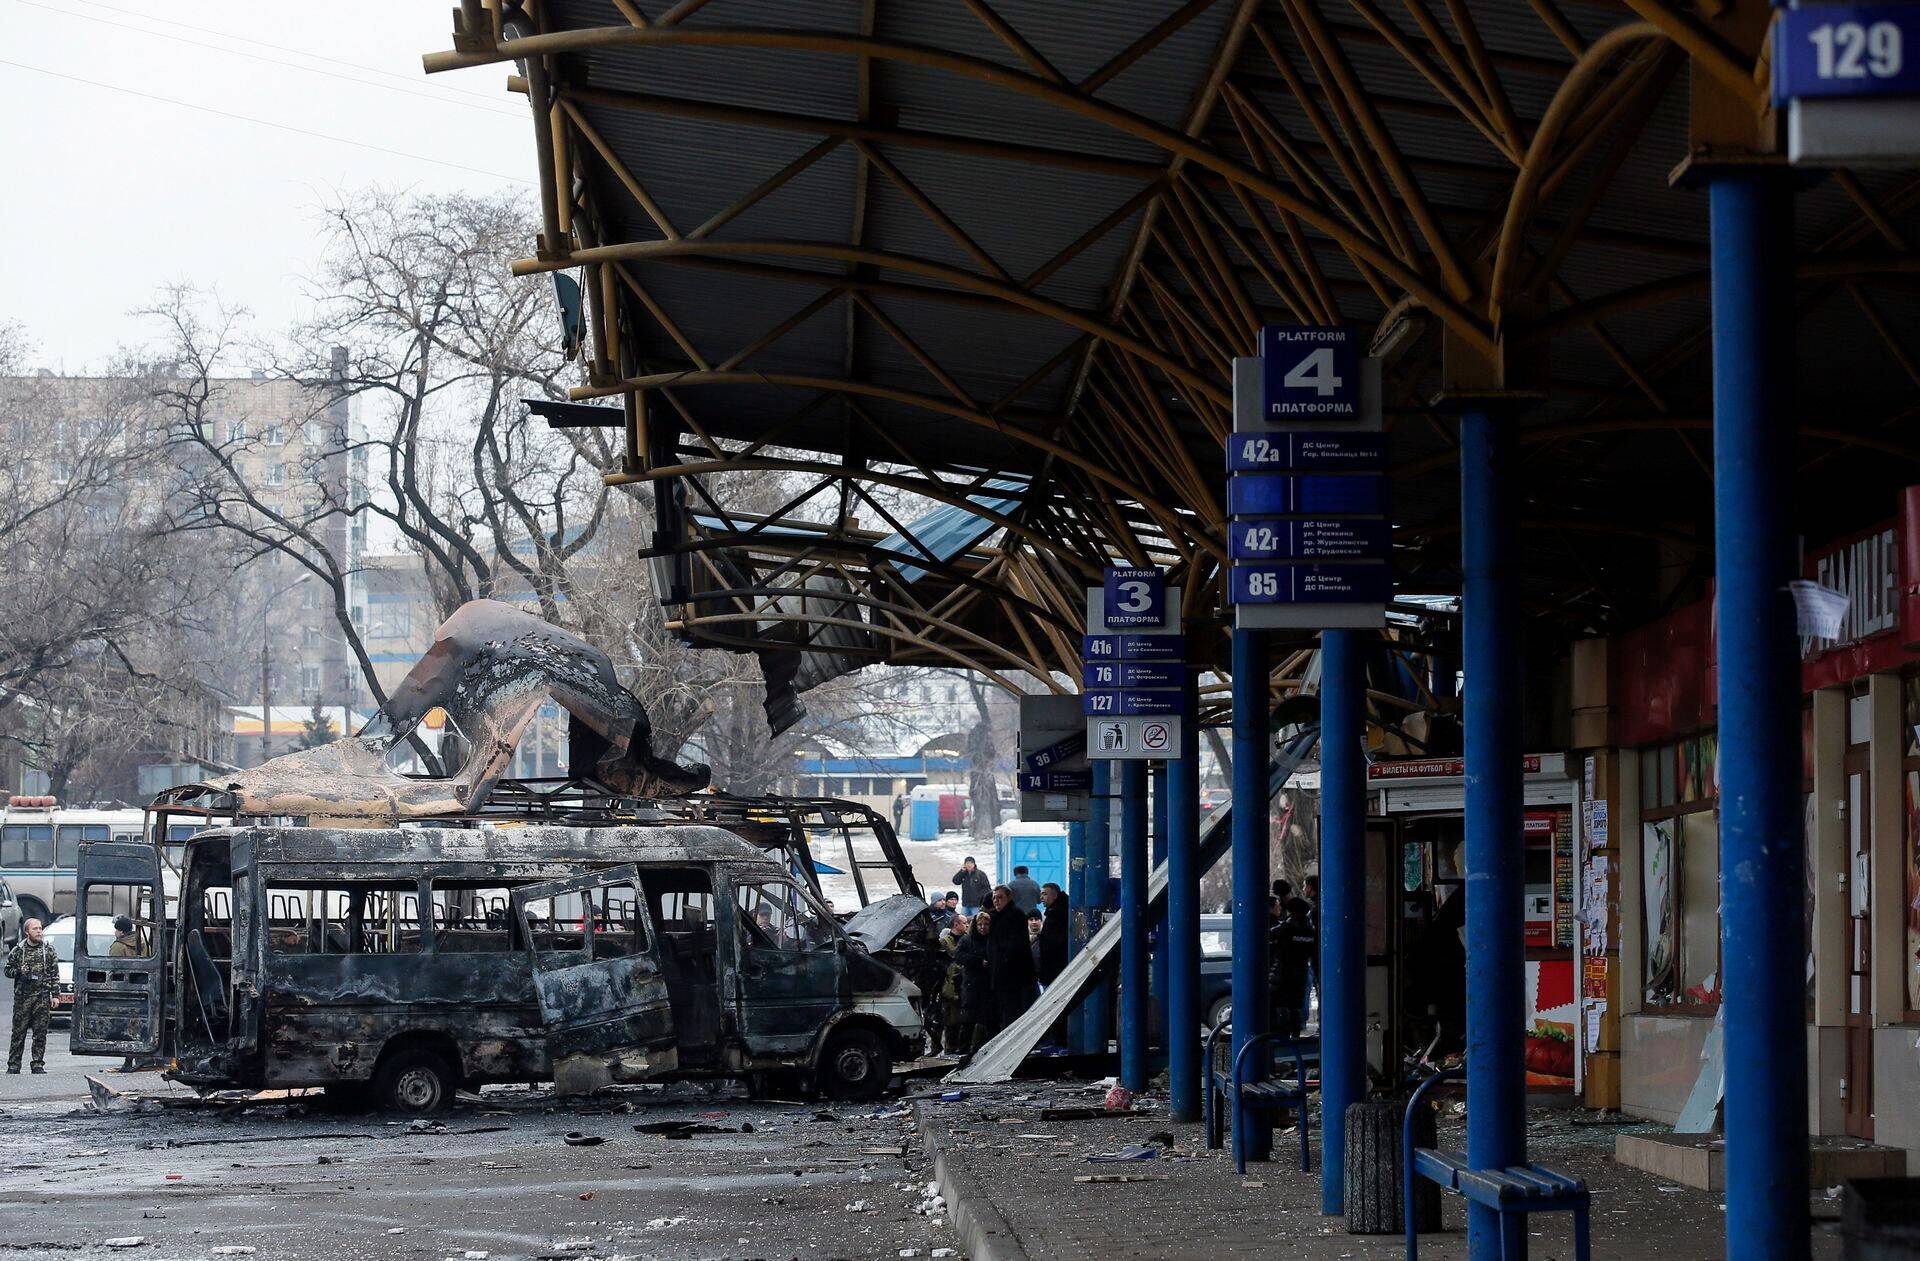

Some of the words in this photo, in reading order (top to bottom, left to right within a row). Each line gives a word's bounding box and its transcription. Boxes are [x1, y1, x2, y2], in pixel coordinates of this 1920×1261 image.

[1808, 21, 1903, 79] 129
[1278, 331, 1346, 342] PLATFORM
[1283, 348, 1343, 397] 4
[1272, 402, 1353, 414] ПЛАТФОРМА
[1242, 439, 1280, 462] 42а
[1244, 527, 1279, 551] 42г
[1112, 570, 1156, 578] PLATFORM
[1249, 572, 1278, 597] 85
[1117, 581, 1152, 613] 3
[1096, 667, 1112, 682] 76
[1090, 695, 1113, 710] 127
[1035, 752, 1050, 767] 36
[1382, 766, 1409, 775] БИЛЕТЫ
[1418, 765, 1443, 773] ФУТБОЛ
[1029, 775, 1041, 787] 74
